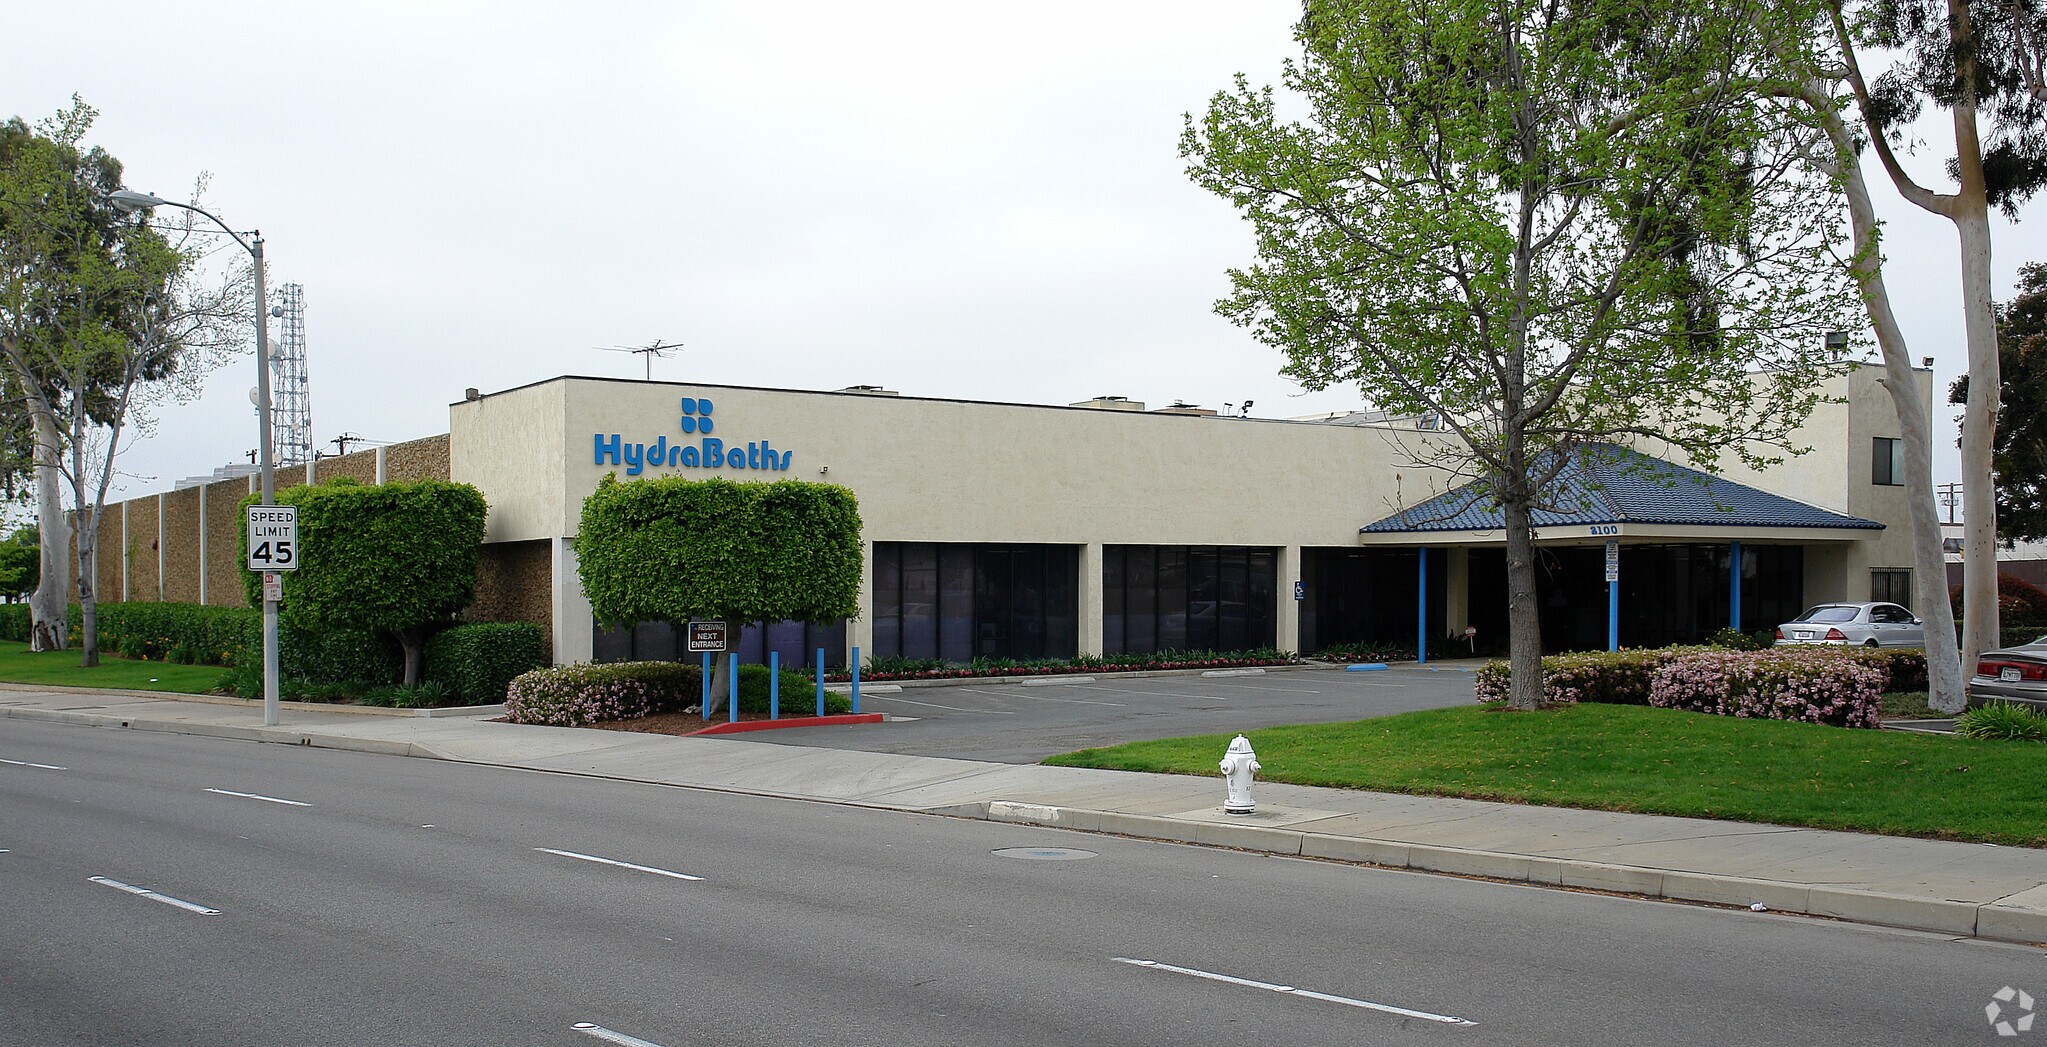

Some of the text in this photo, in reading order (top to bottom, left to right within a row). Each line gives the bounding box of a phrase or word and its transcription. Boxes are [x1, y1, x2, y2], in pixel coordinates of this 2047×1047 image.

[594, 433, 793, 475] HydraBaths
[251, 512, 294, 522] SPEED
[255, 526, 290, 536] LIMIT
[252, 541, 293, 564] 45
[697, 623, 724, 631] RECEIVING
[697, 632, 718, 640] NEXT
[691, 640, 724, 648] ENTRANCE
